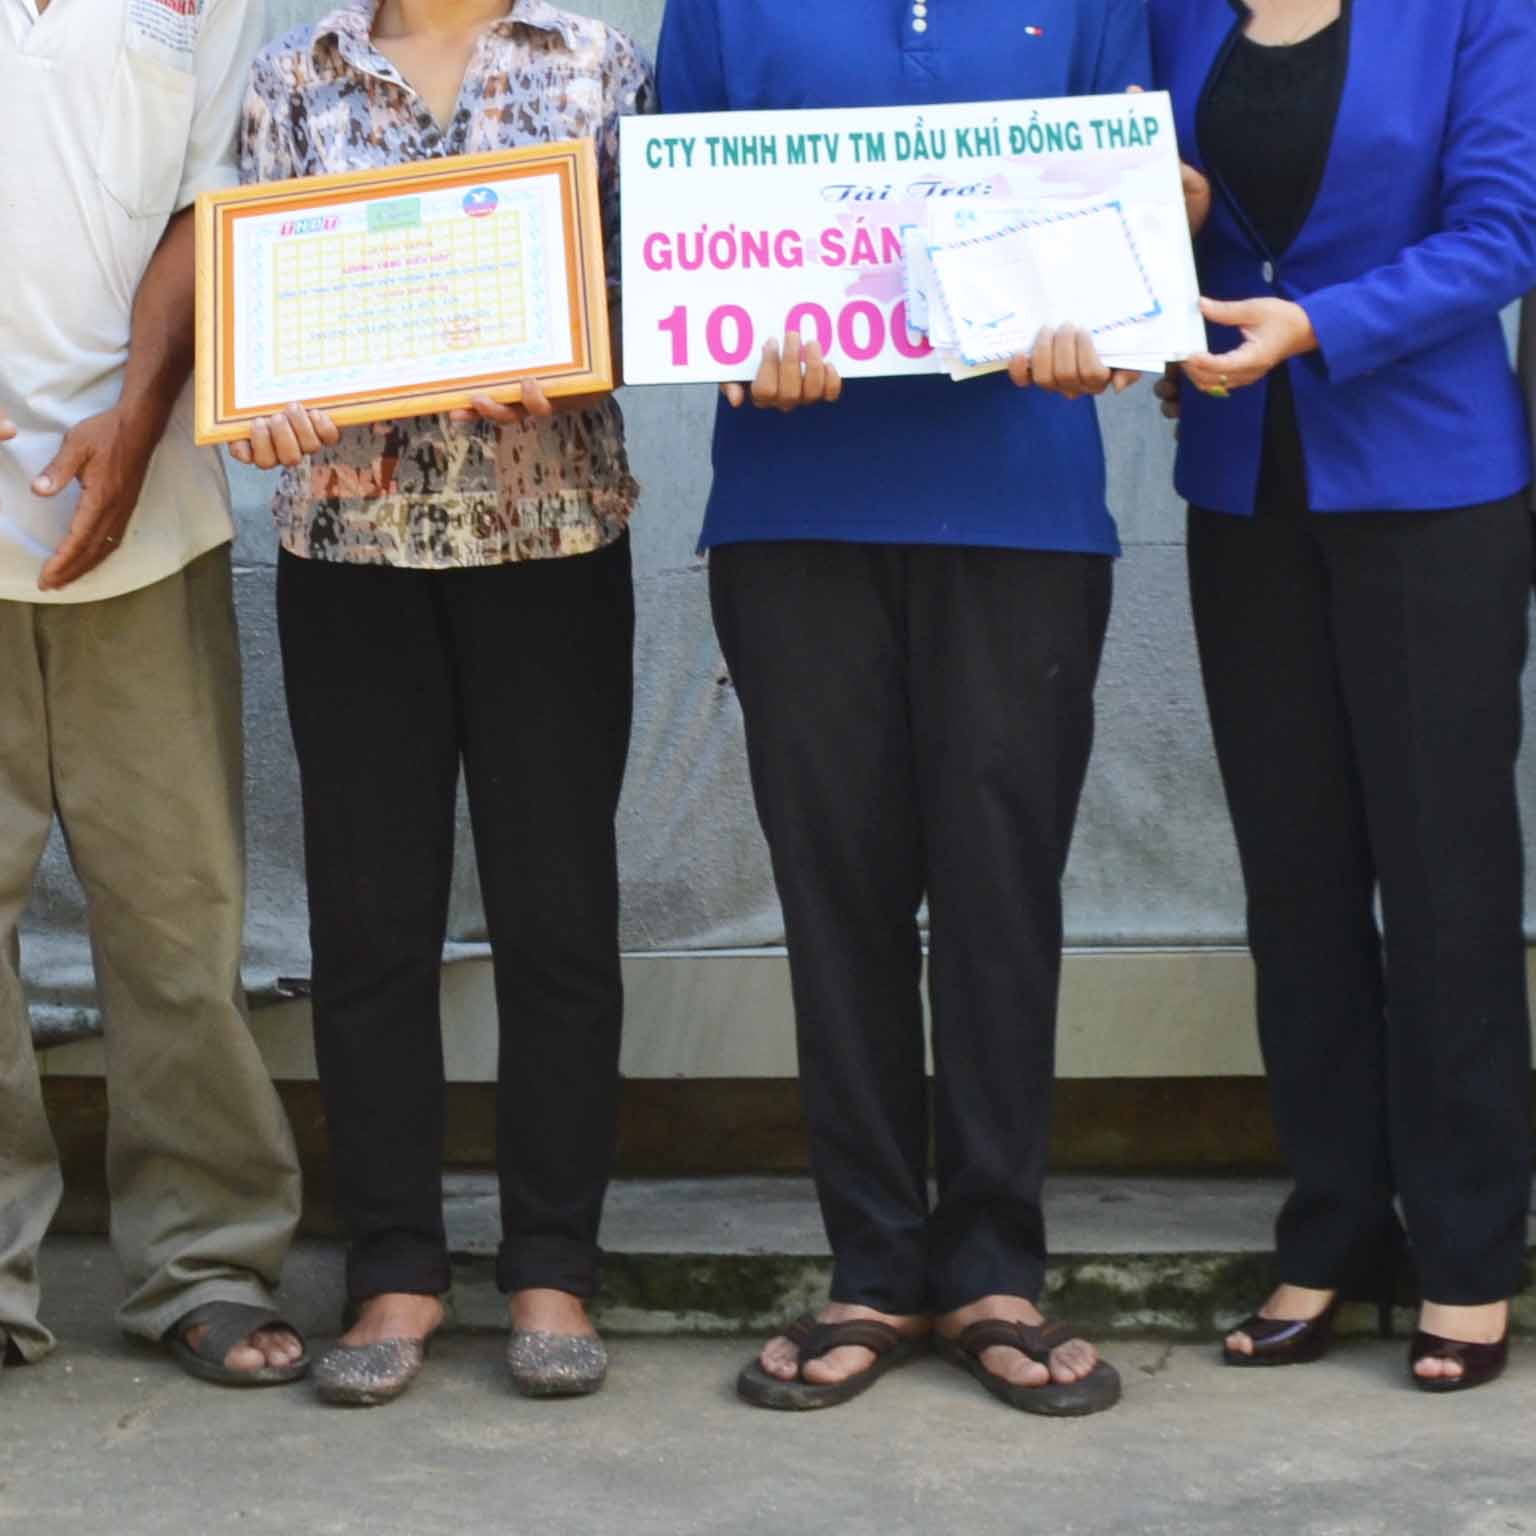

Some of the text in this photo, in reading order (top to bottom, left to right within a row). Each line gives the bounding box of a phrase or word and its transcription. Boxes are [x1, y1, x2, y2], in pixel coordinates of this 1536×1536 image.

[645, 137, 696, 169] CTY
[704, 135, 778, 167] TNHH
[785, 133, 840, 165] MTV
[848, 131, 886, 162] TM
[1088, 108, 1160, 149] THÁP
[642, 215, 903, 272] GƯƠNG SÁN
